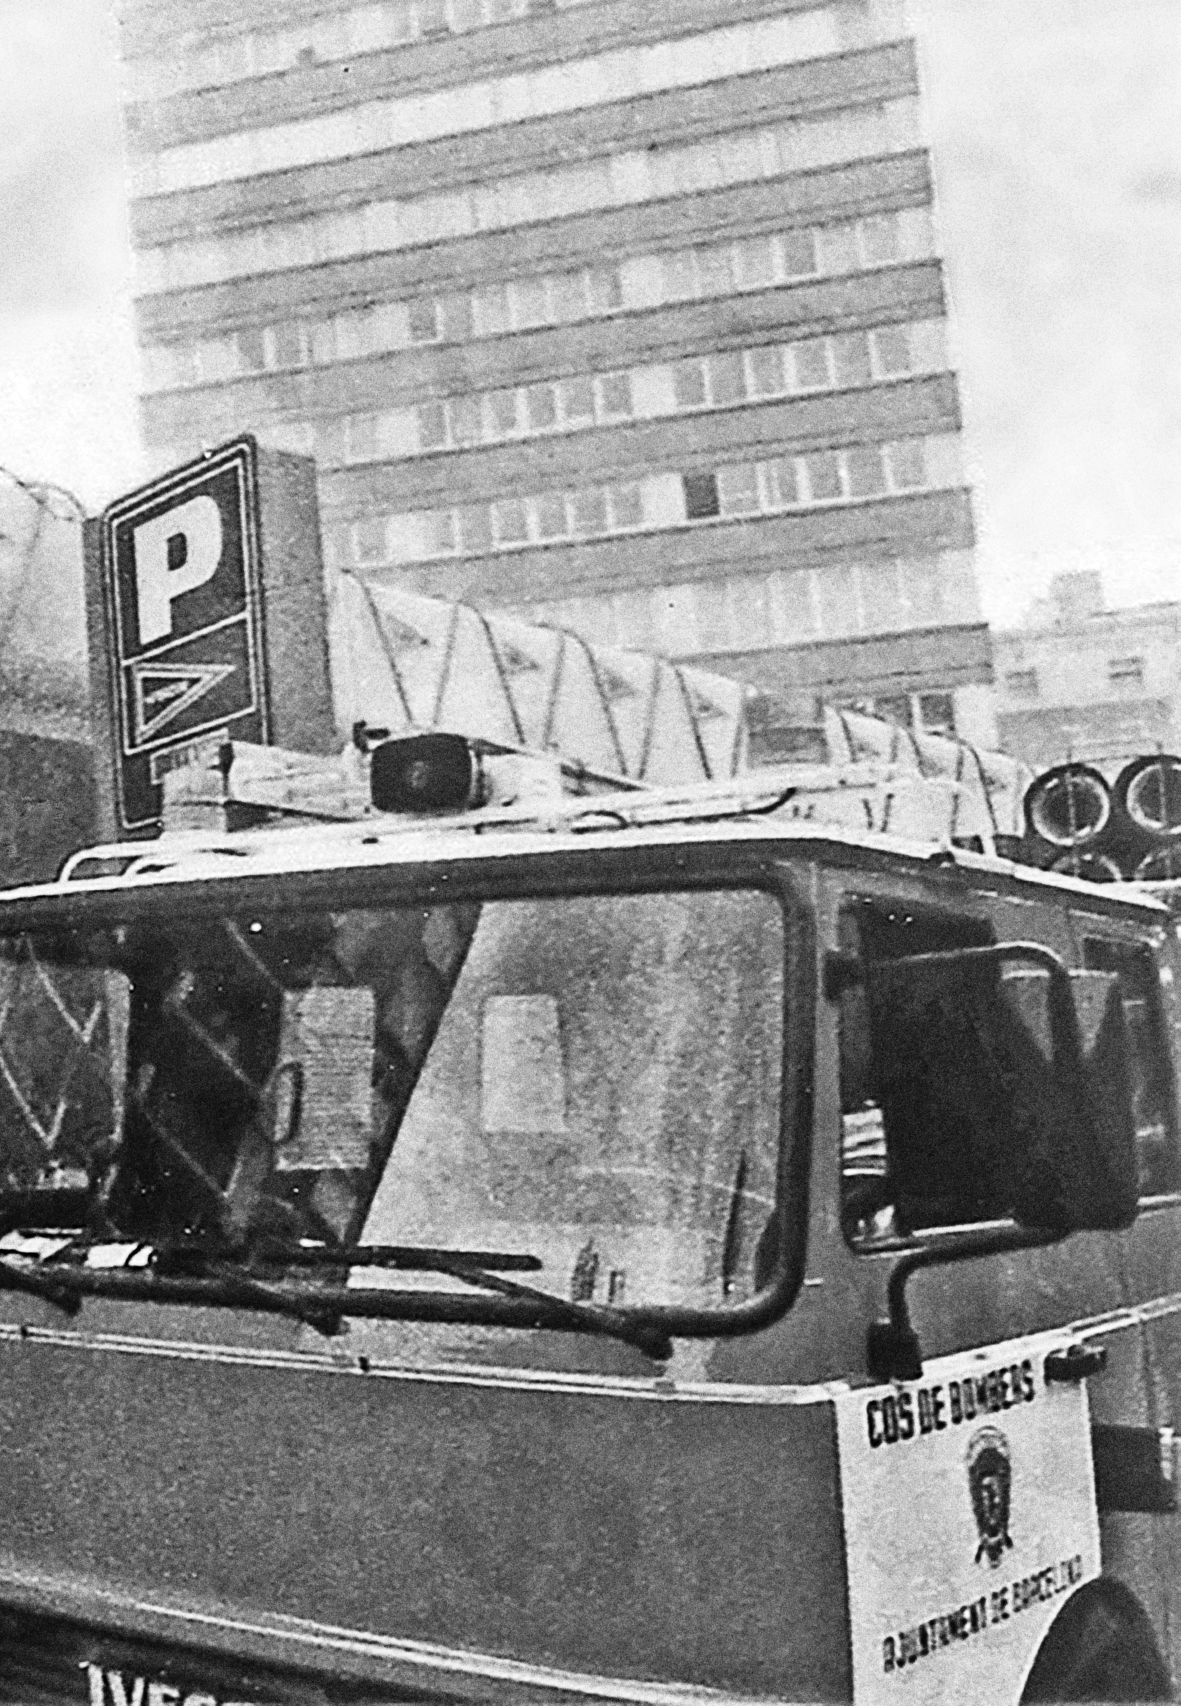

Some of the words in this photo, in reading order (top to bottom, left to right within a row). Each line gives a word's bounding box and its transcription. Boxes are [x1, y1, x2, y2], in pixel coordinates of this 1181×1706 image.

[133, 495, 223, 646] P
[866, 1391, 915, 1448] COS
[917, 1385, 948, 1435] DE
